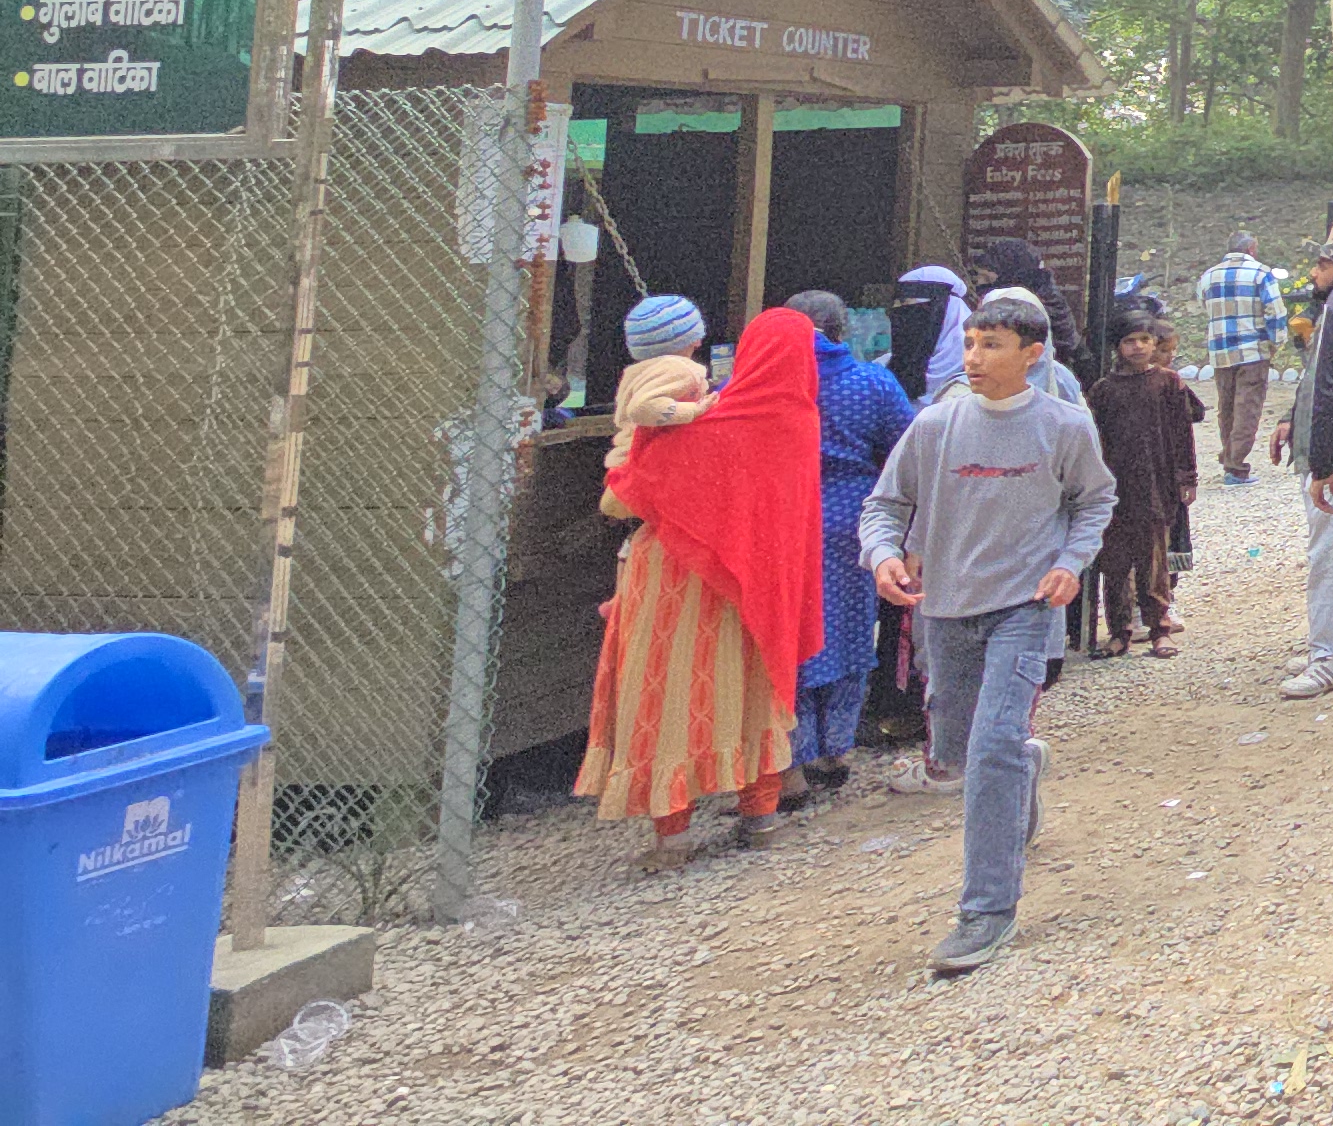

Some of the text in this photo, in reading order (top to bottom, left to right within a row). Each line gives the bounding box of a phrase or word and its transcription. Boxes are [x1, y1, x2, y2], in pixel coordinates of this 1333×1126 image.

[676, 10, 871, 60] TICKET COUNTER
[32, 49, 160, 95] बाल वाटिका
[986, 166, 1023, 187] Entry
[77, 822, 192, 874] Nilkamal
